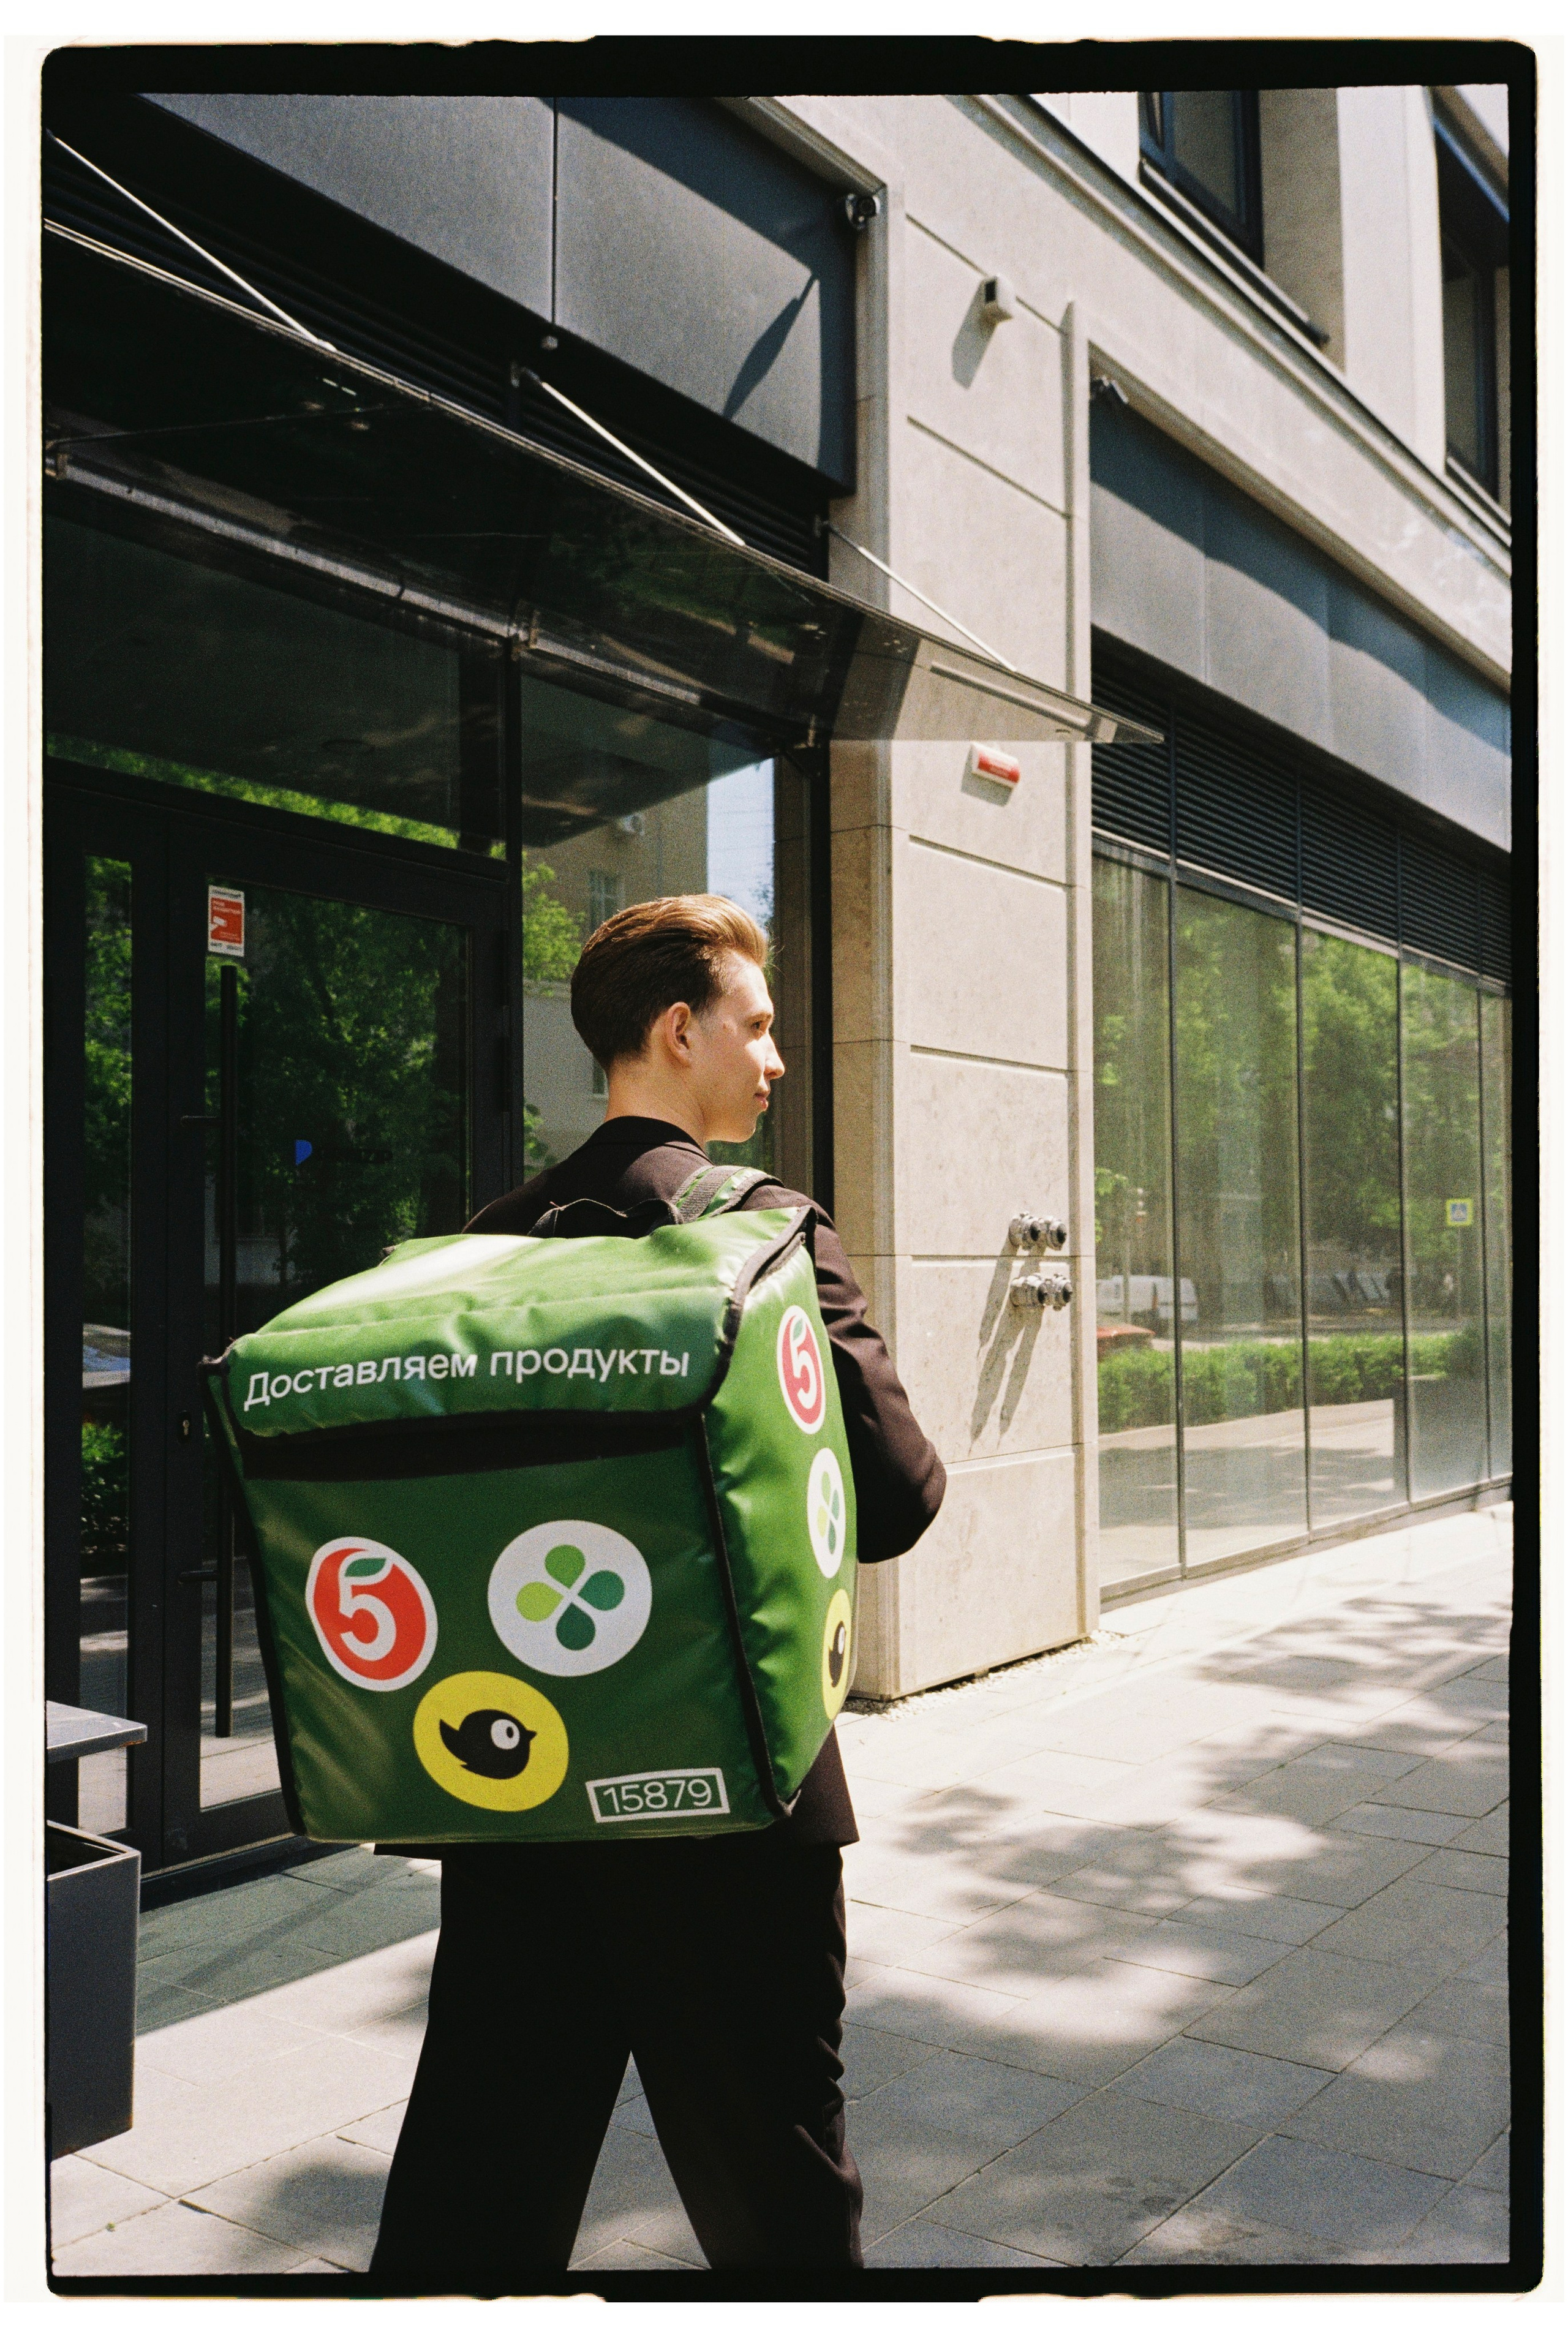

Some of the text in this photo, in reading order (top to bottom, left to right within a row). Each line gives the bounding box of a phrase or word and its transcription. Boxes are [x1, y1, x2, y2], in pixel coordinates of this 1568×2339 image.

[244, 1347, 690, 1411] Доставляем продукты
[790, 1317, 818, 1410] 5
[338, 1553, 397, 1662] 5
[602, 1779, 713, 1814] 15879
